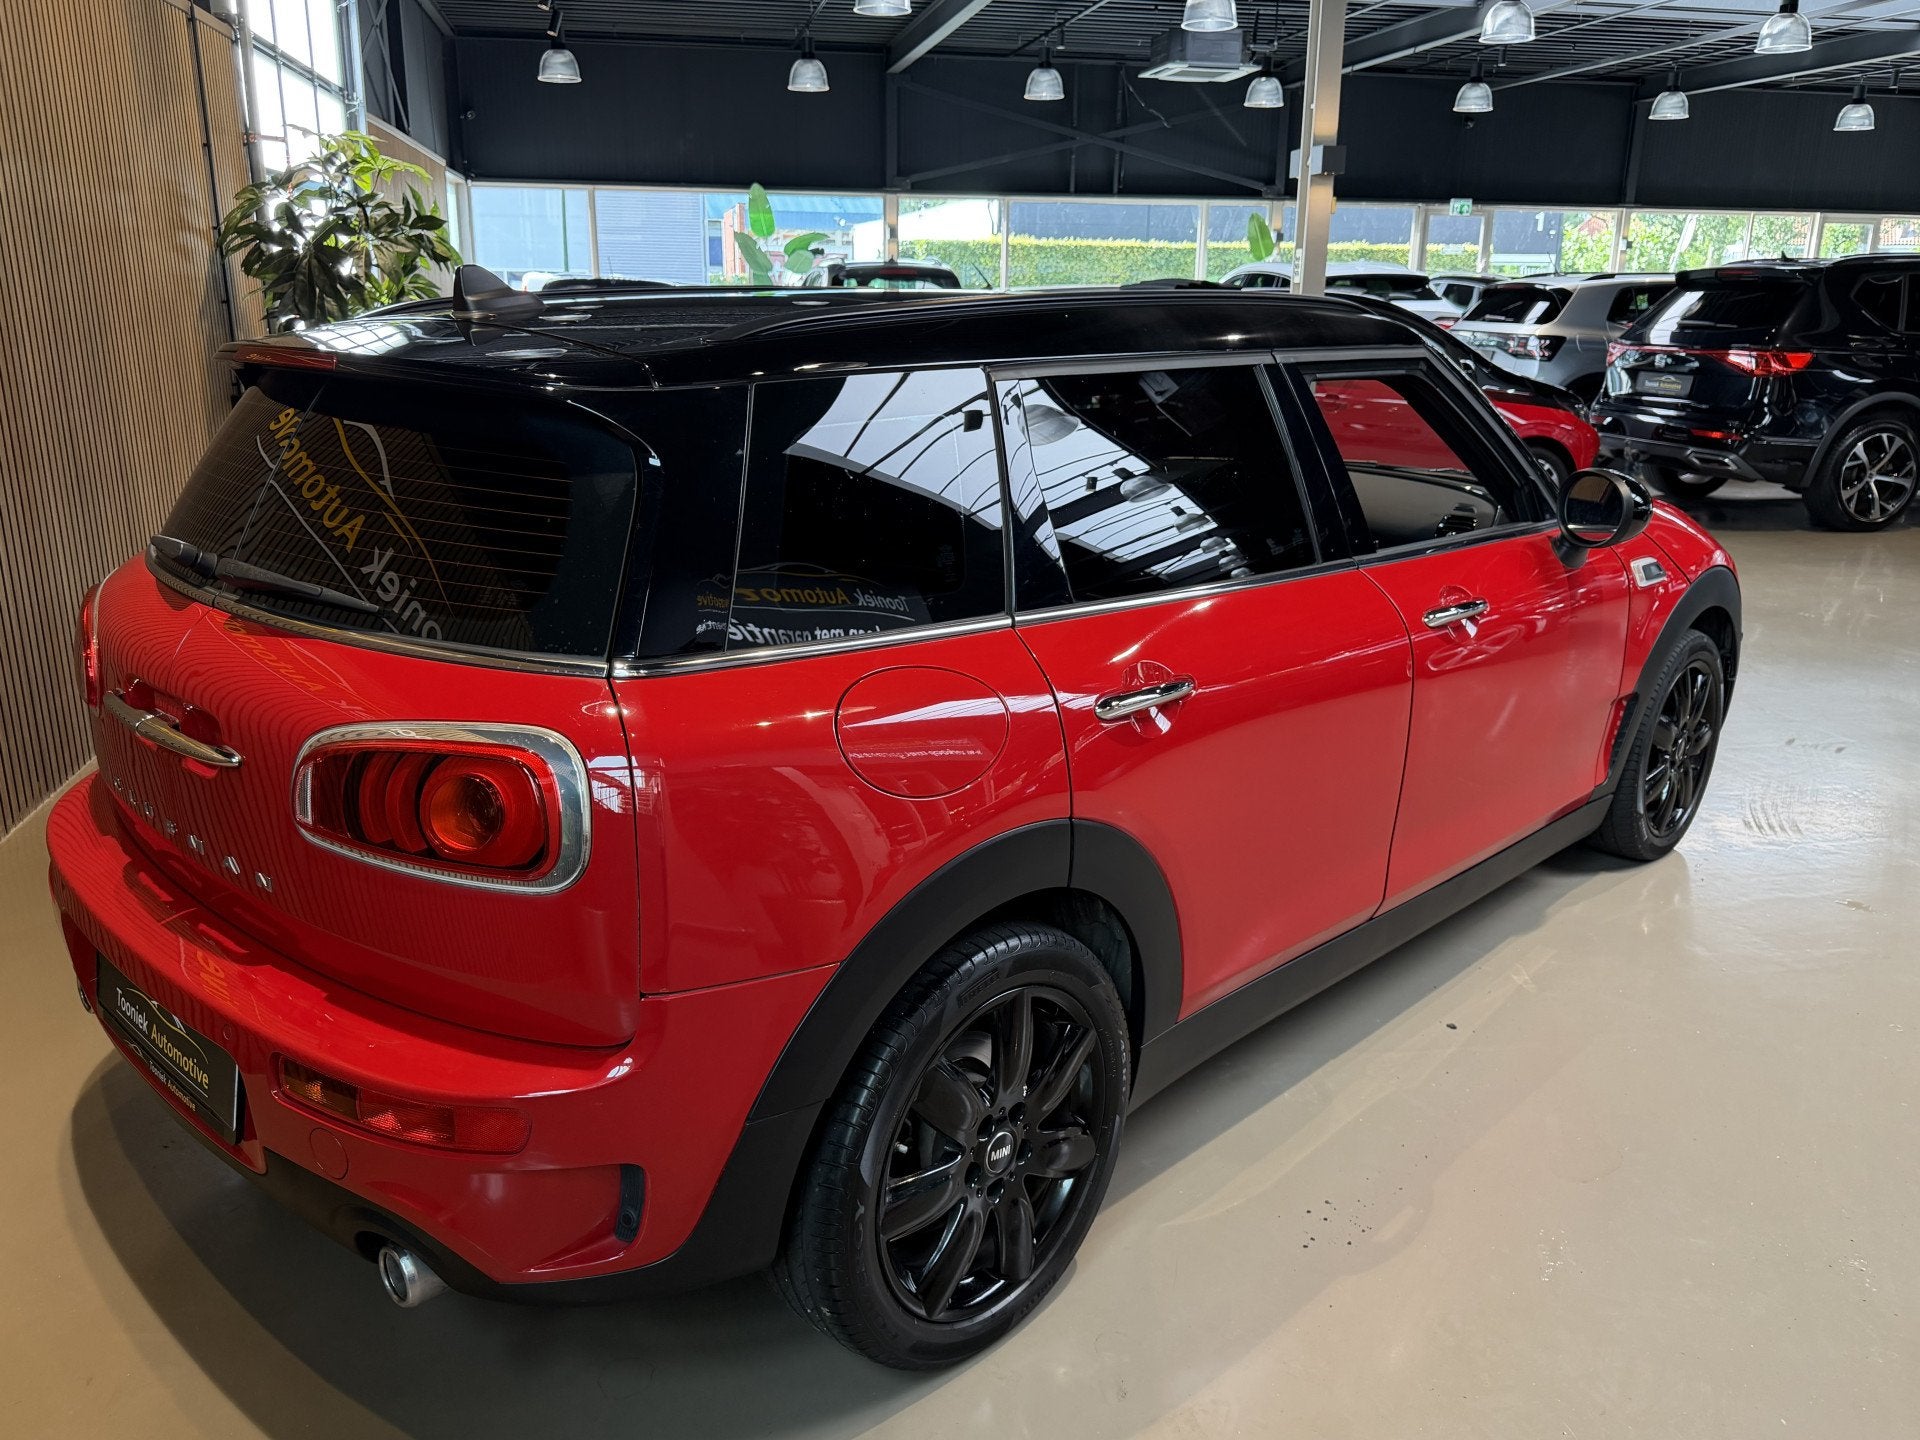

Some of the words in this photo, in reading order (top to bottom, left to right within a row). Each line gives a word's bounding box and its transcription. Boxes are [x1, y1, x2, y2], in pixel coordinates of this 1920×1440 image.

[116, 987, 149, 1034] Tooniek
[151, 1023, 209, 1089] Automotive
[150, 1061, 167, 1085] Tooniek
[168, 1079, 196, 1112] Automotive
[991, 1144, 1011, 1161] MINI
